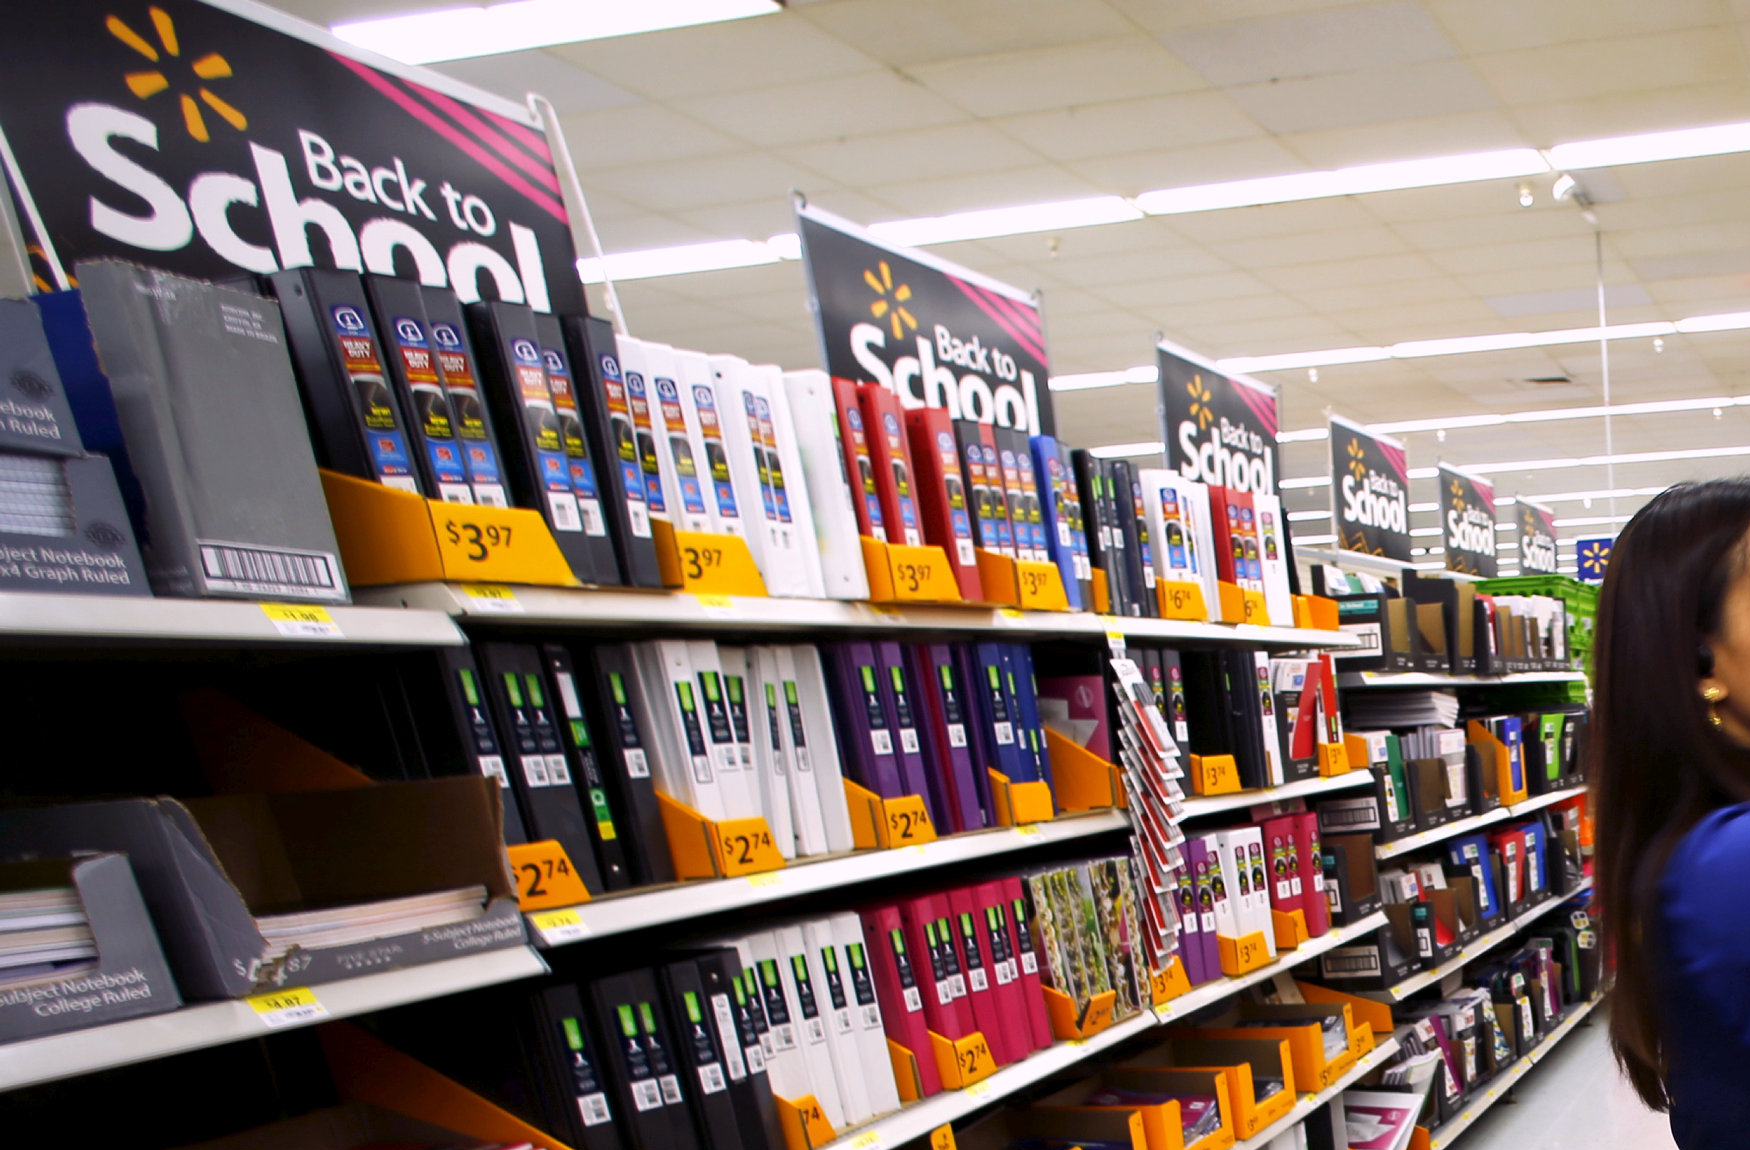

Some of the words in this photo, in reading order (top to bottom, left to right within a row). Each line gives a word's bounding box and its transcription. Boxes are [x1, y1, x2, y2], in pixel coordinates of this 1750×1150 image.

[298, 128, 442, 221] Back
[440, 178, 497, 236] to
[67, 103, 550, 313] School
[934, 324, 989, 376] Back
[990, 346, 1018, 382] to
[850, 323, 1041, 436] School
[0, 402, 55, 422] ebook
[12, 420, 61, 440] Ruled
[1220, 417, 1250, 450] Back
[1249, 431, 1263, 455] to
[1179, 421, 1273, 495] School
[1342, 475, 1407, 534] School
[1448, 509, 1496, 557] School
[26, 566, 80, 584] Graph
[82, 568, 131, 585] Ruled
[42, 549, 127, 568] Notebook
[34, 990, 103, 1018] College
[103, 983, 152, 1007] Ruled
[63, 967, 148, 996] Notebook
